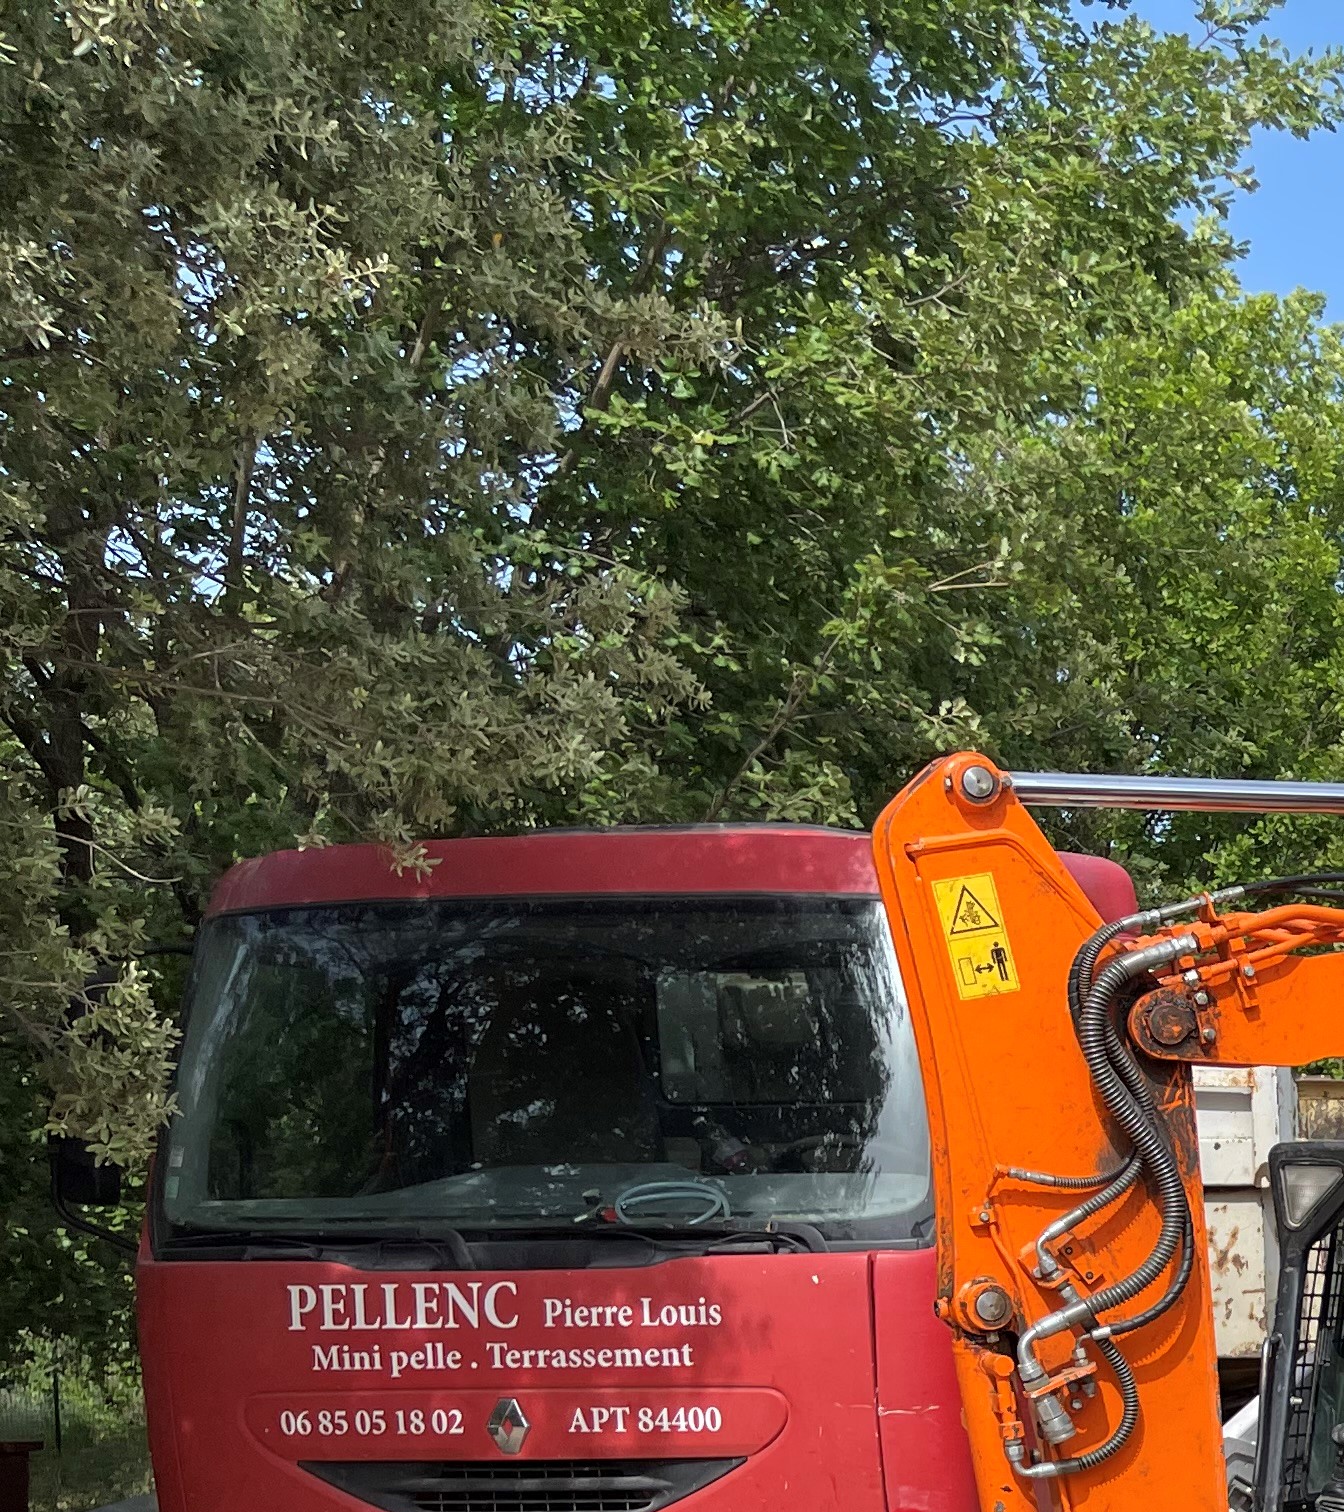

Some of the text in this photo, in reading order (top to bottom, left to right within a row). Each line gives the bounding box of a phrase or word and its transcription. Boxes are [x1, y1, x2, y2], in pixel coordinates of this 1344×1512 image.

[286, 1281, 722, 1331] PELLENC Pierre Louis
[311, 1344, 383, 1371] Mini
[389, 1342, 462, 1379] pelle
[486, 1342, 695, 1369] Terrassement
[280, 1406, 722, 1435] 06 85 05 18 02 APT 84400
